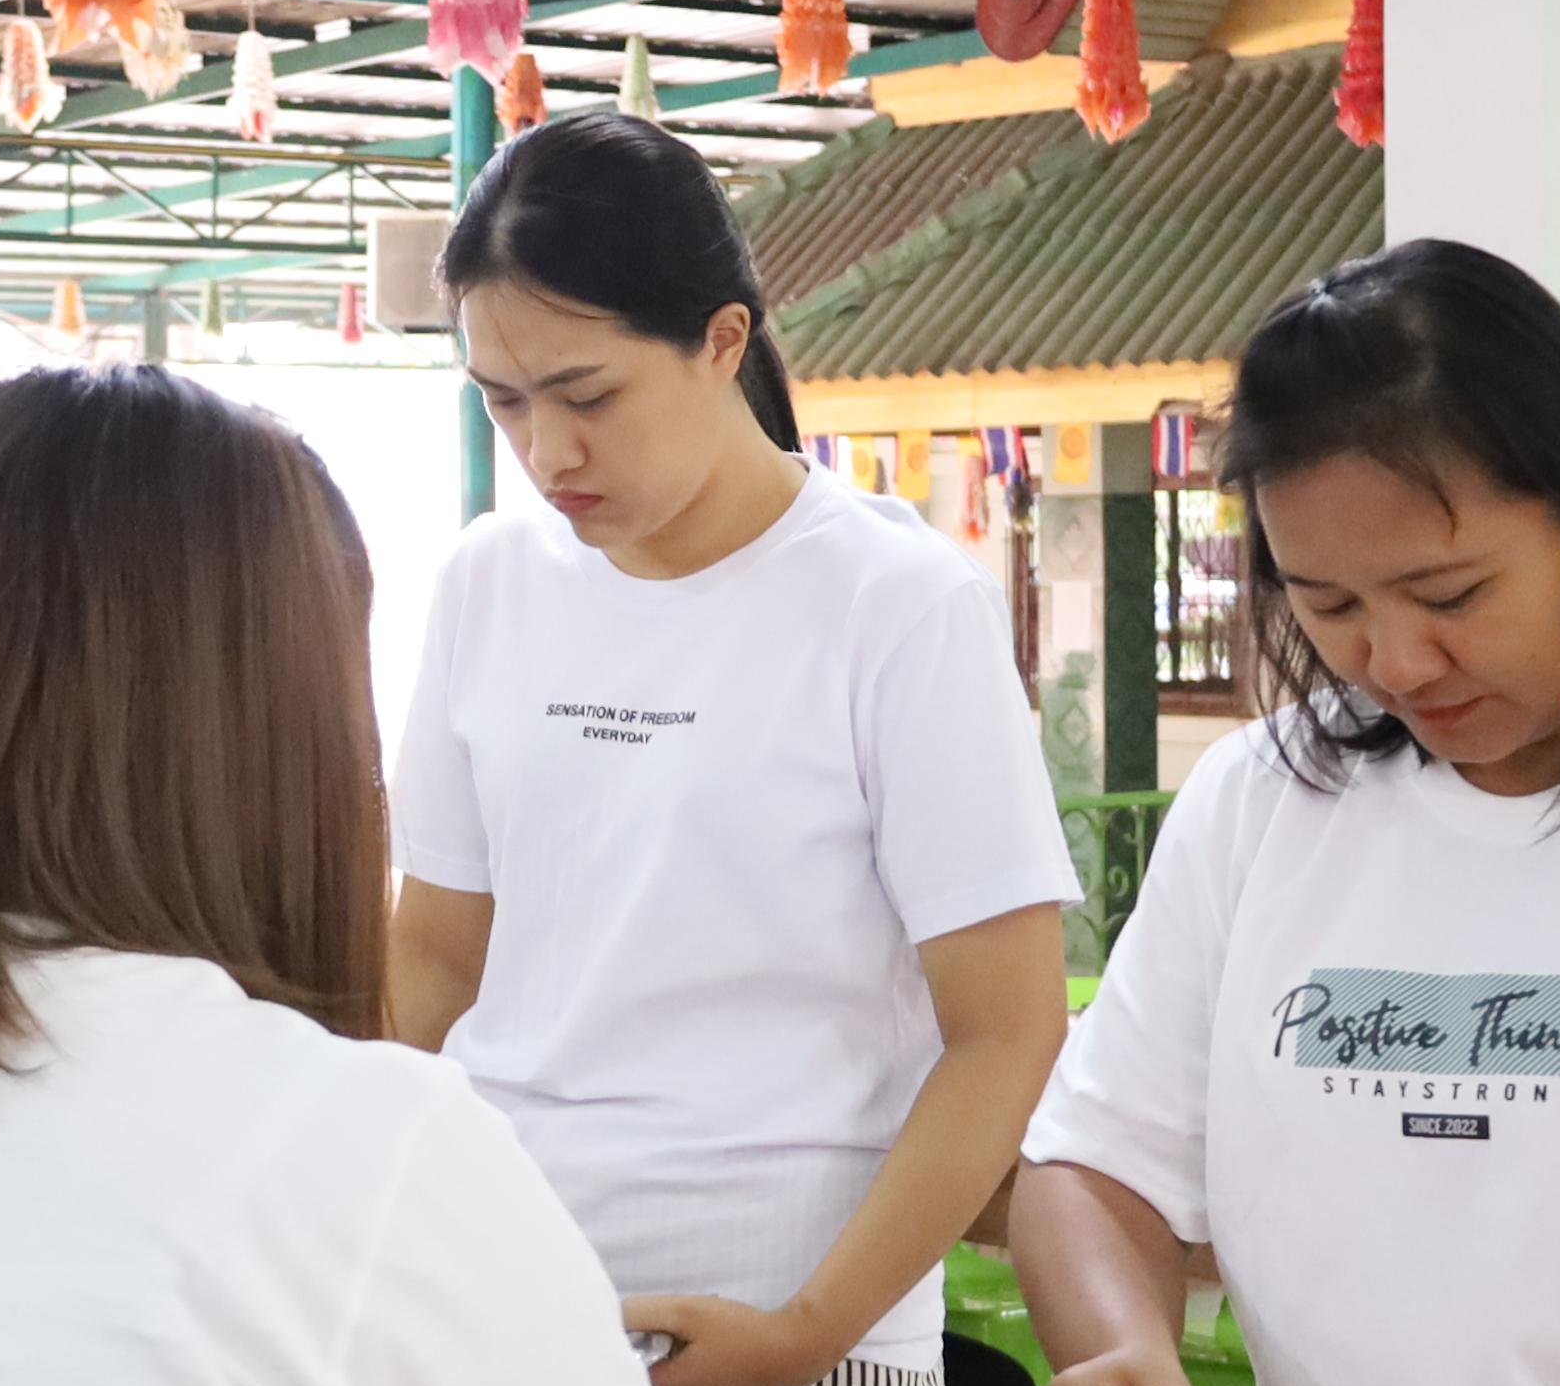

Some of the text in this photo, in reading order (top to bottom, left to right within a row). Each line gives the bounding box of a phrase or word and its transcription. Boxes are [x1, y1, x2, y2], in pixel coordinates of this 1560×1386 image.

[546, 703, 696, 725] SENSATION OF FREEDOM
[582, 726, 652, 744] EVERYDAY
[1271, 982, 1448, 1066] Positive
